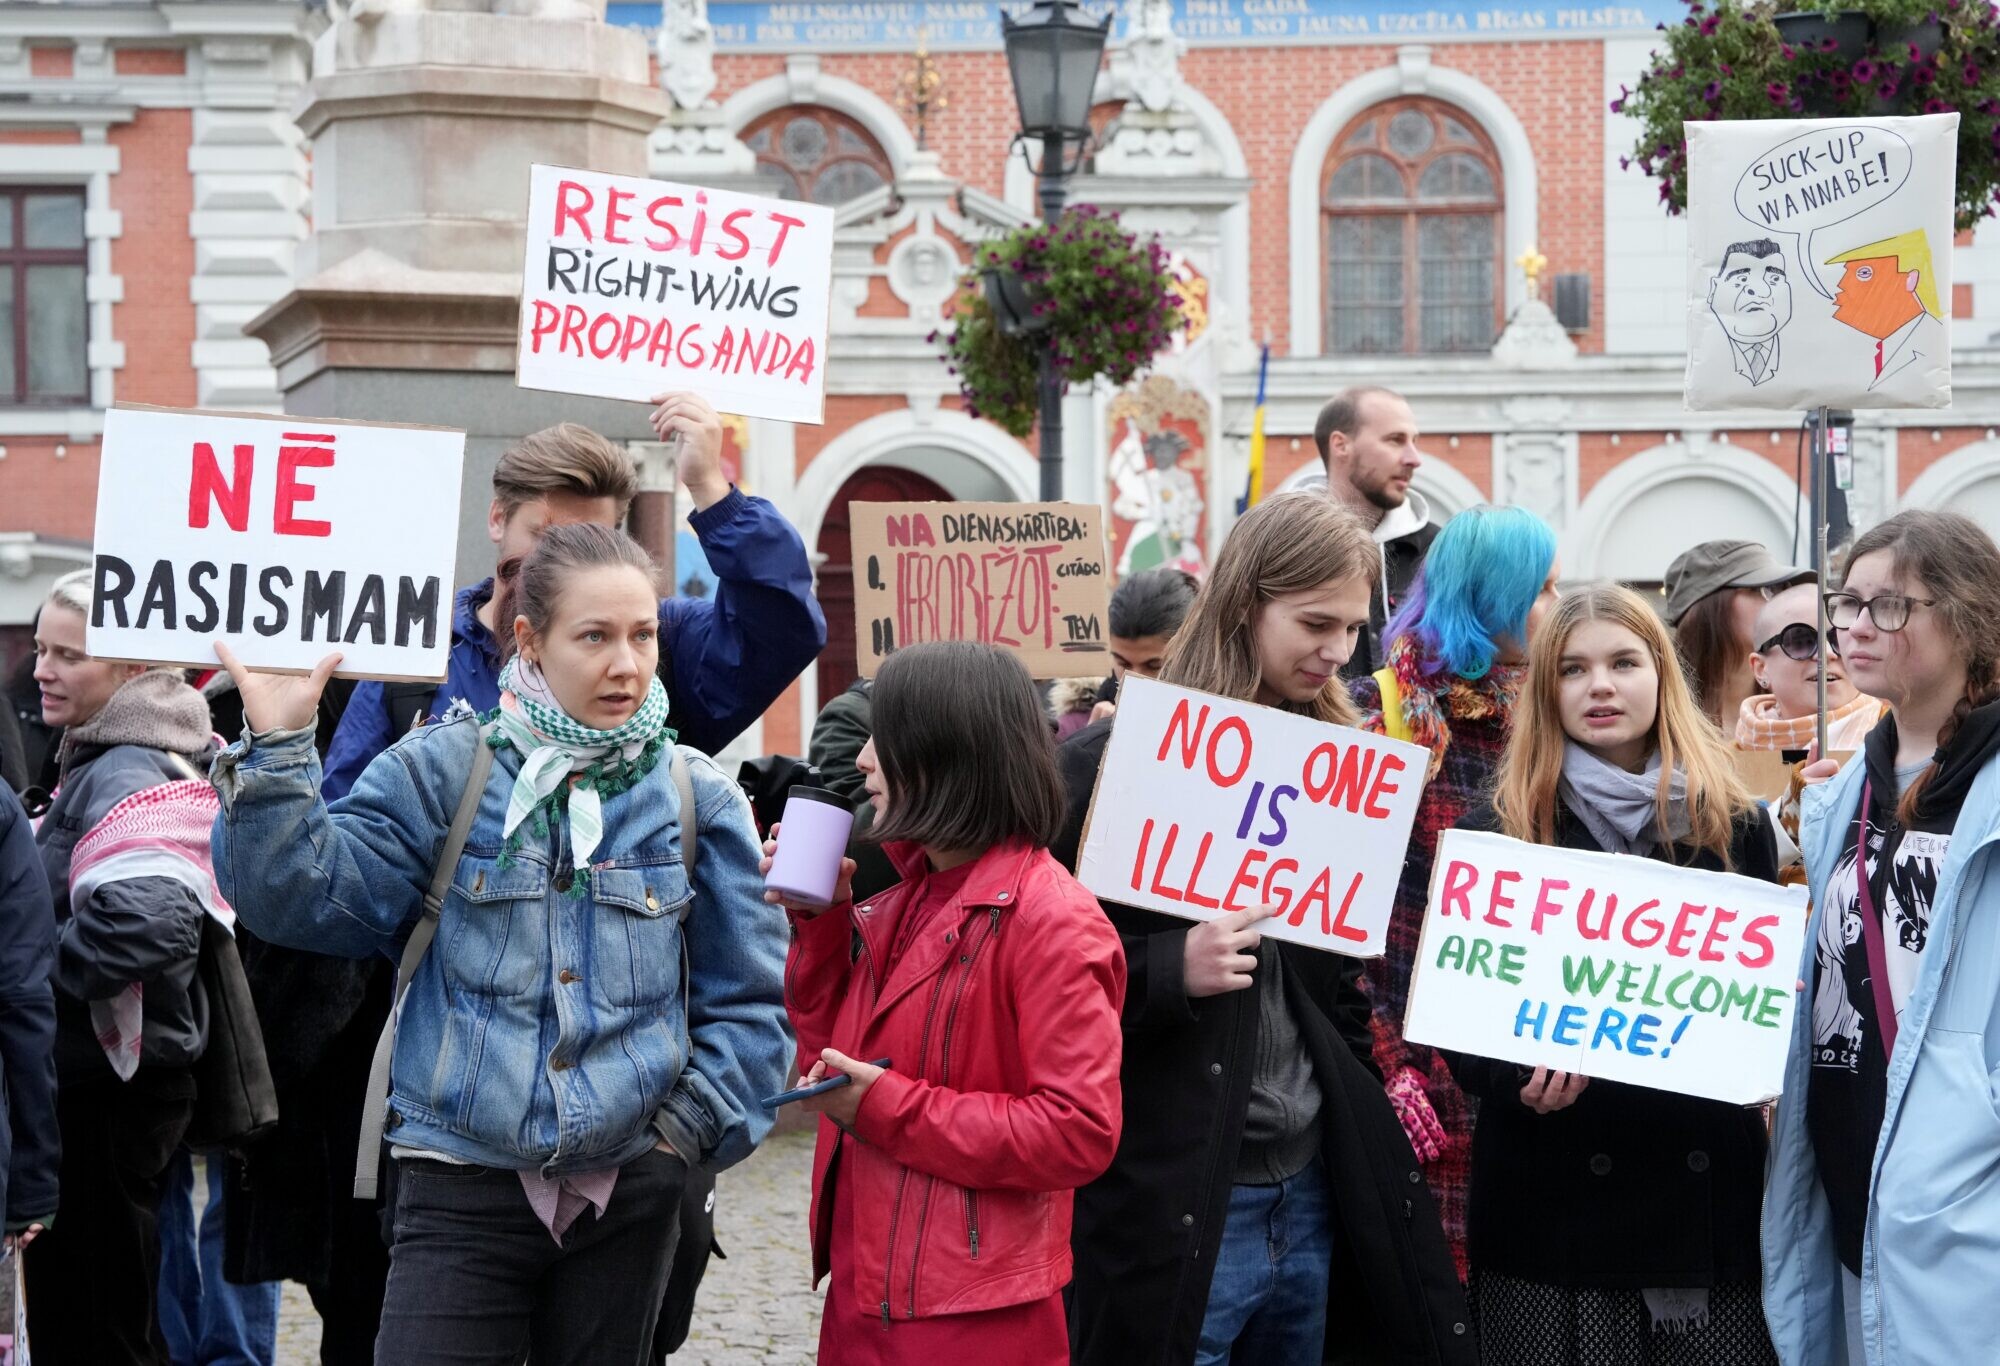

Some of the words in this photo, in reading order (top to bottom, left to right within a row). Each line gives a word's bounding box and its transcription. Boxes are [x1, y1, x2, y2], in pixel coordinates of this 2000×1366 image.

[1252, 16, 1288, 34] NO
[1753, 131, 1864, 191] SUCK-UP
[1758, 151, 1890, 224] WANNABE!
[531, 299, 815, 385] PROPAGANDA
[188, 432, 336, 537] NĒ
[886, 513, 936, 547] NA
[91, 554, 440, 649] RASISMAM
[1056, 557, 1101, 577] CITĀDO
[1062, 612, 1101, 641] TEVI
[1157, 698, 1252, 788] NO
[1303, 742, 1406, 819] ONE
[1236, 781, 1299, 847] IS
[1130, 818, 1368, 943] ILLEGAL
[1440, 860, 1780, 969] REFUGEES
[1436, 935, 1527, 986] ARE
[1562, 954, 1790, 1029] WELCOME
[1513, 998, 1693, 1059] HERE!
